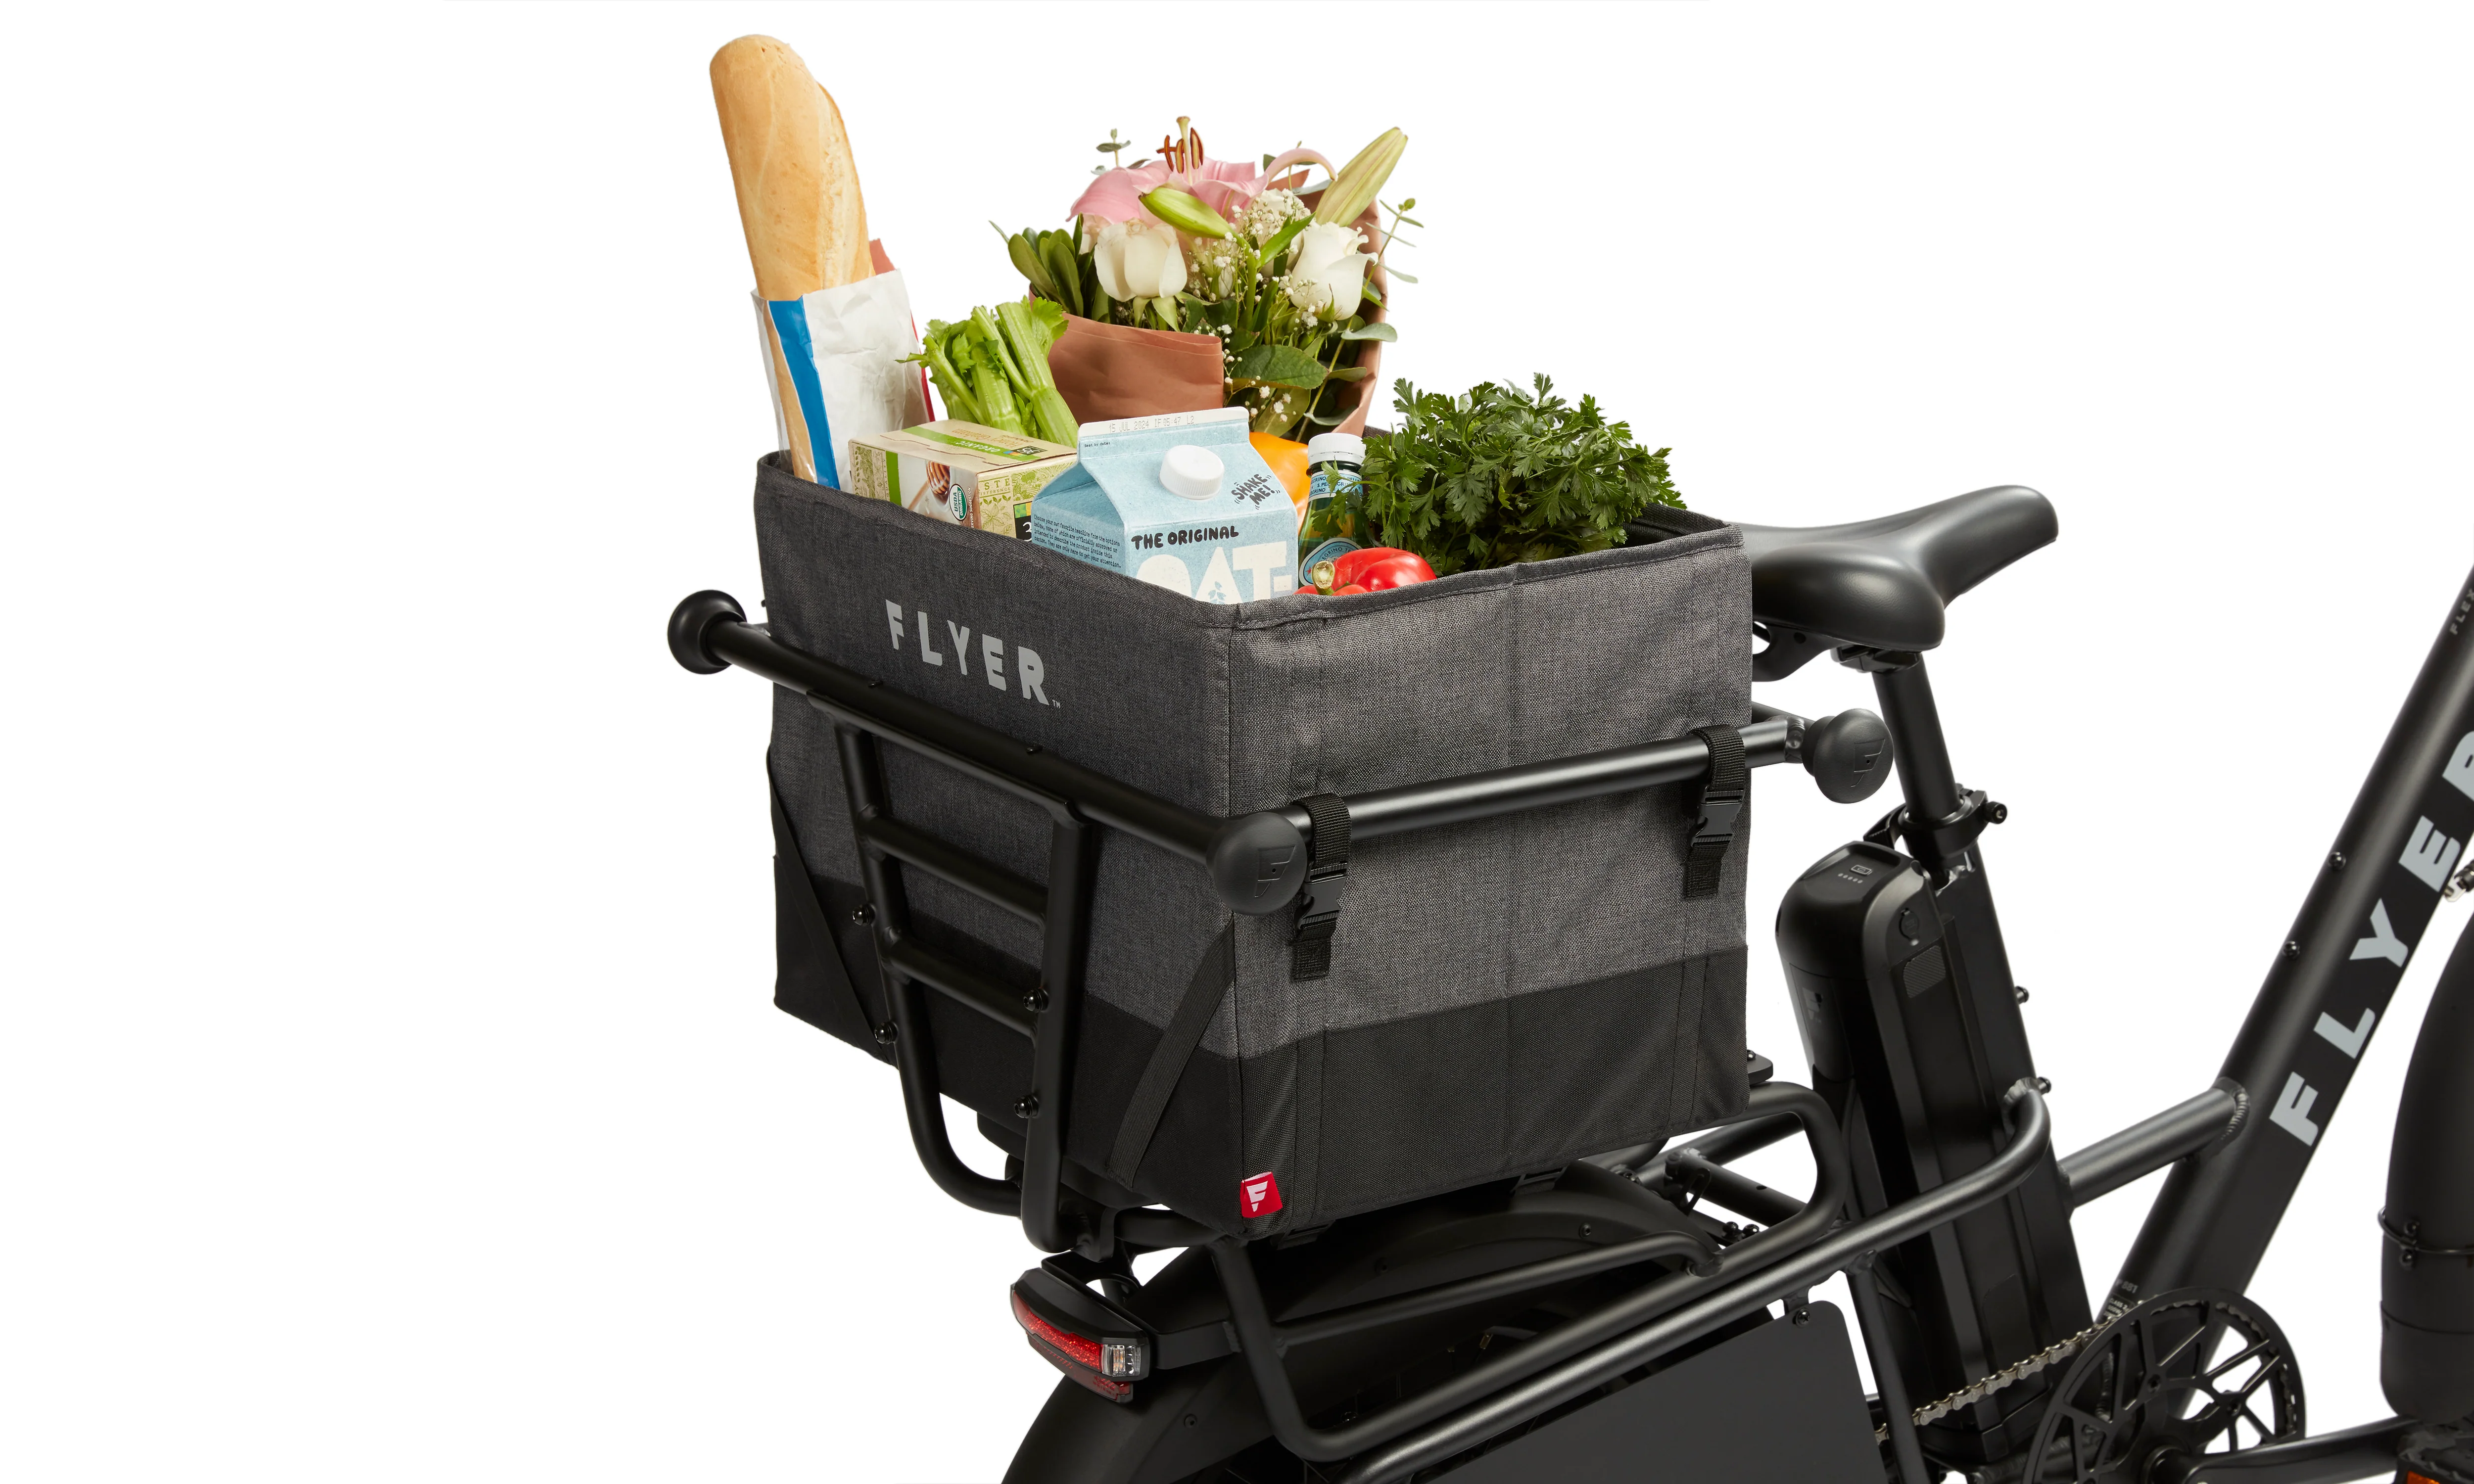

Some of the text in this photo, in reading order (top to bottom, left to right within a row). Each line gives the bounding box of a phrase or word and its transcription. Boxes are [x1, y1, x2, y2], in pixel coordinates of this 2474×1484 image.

[1109, 423, 1115, 433] 15
[1119, 421, 1130, 432] JUL
[1134, 419, 1149, 430] 2024
[955, 441, 1000, 452] ORGANIC
[979, 487, 1010, 496] IFFERENCE
[1231, 474, 1268, 500] SHAKE
[1249, 484, 1275, 505] ME!
[1034, 520, 1045, 530] below,
[1076, 536, 1094, 547] officially
[1095, 543, 1112, 552] approved
[1034, 528, 1048, 538] intended
[1054, 536, 1069, 545] describe
[1076, 543, 1090, 552] product
[1091, 548, 1103, 556] inside
[1060, 523, 1074, 532] favorite
[1075, 527, 1090, 537] headline
[1105, 537, 1120, 546] options
[1131, 526, 1239, 550] THE ORIGINAL
[1100, 558, 1121, 568] attention.
[1320, 547, 1342, 561] EGRINO
[886, 599, 1049, 705] FLYER
